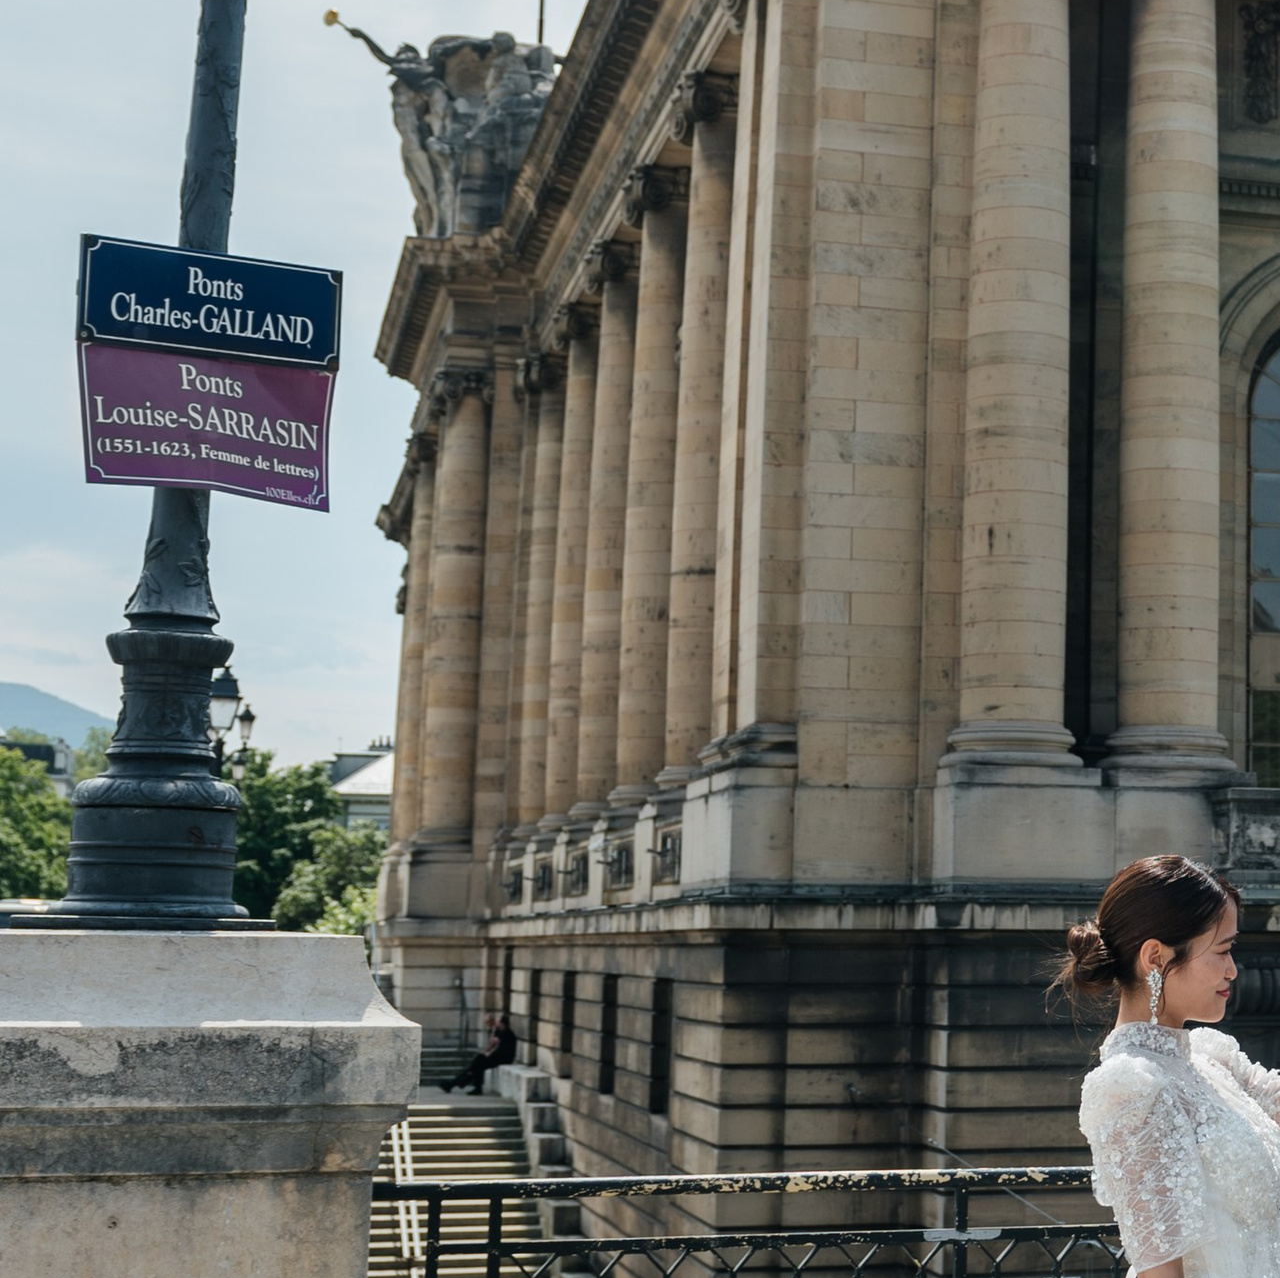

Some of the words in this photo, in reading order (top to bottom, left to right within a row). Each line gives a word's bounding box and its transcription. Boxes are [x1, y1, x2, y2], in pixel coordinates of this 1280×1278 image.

[187, 266, 244, 302] Ponts
[110, 291, 314, 345] Charles-GALLAND
[178, 363, 243, 399] Ponts
[94, 396, 319, 452] Louise-SARRASIN
[96, 437, 196, 460] (1551-1623,
[200, 444, 251, 467] Femme
[254, 454, 270, 471] de
[273, 458, 319, 481] lettres)
